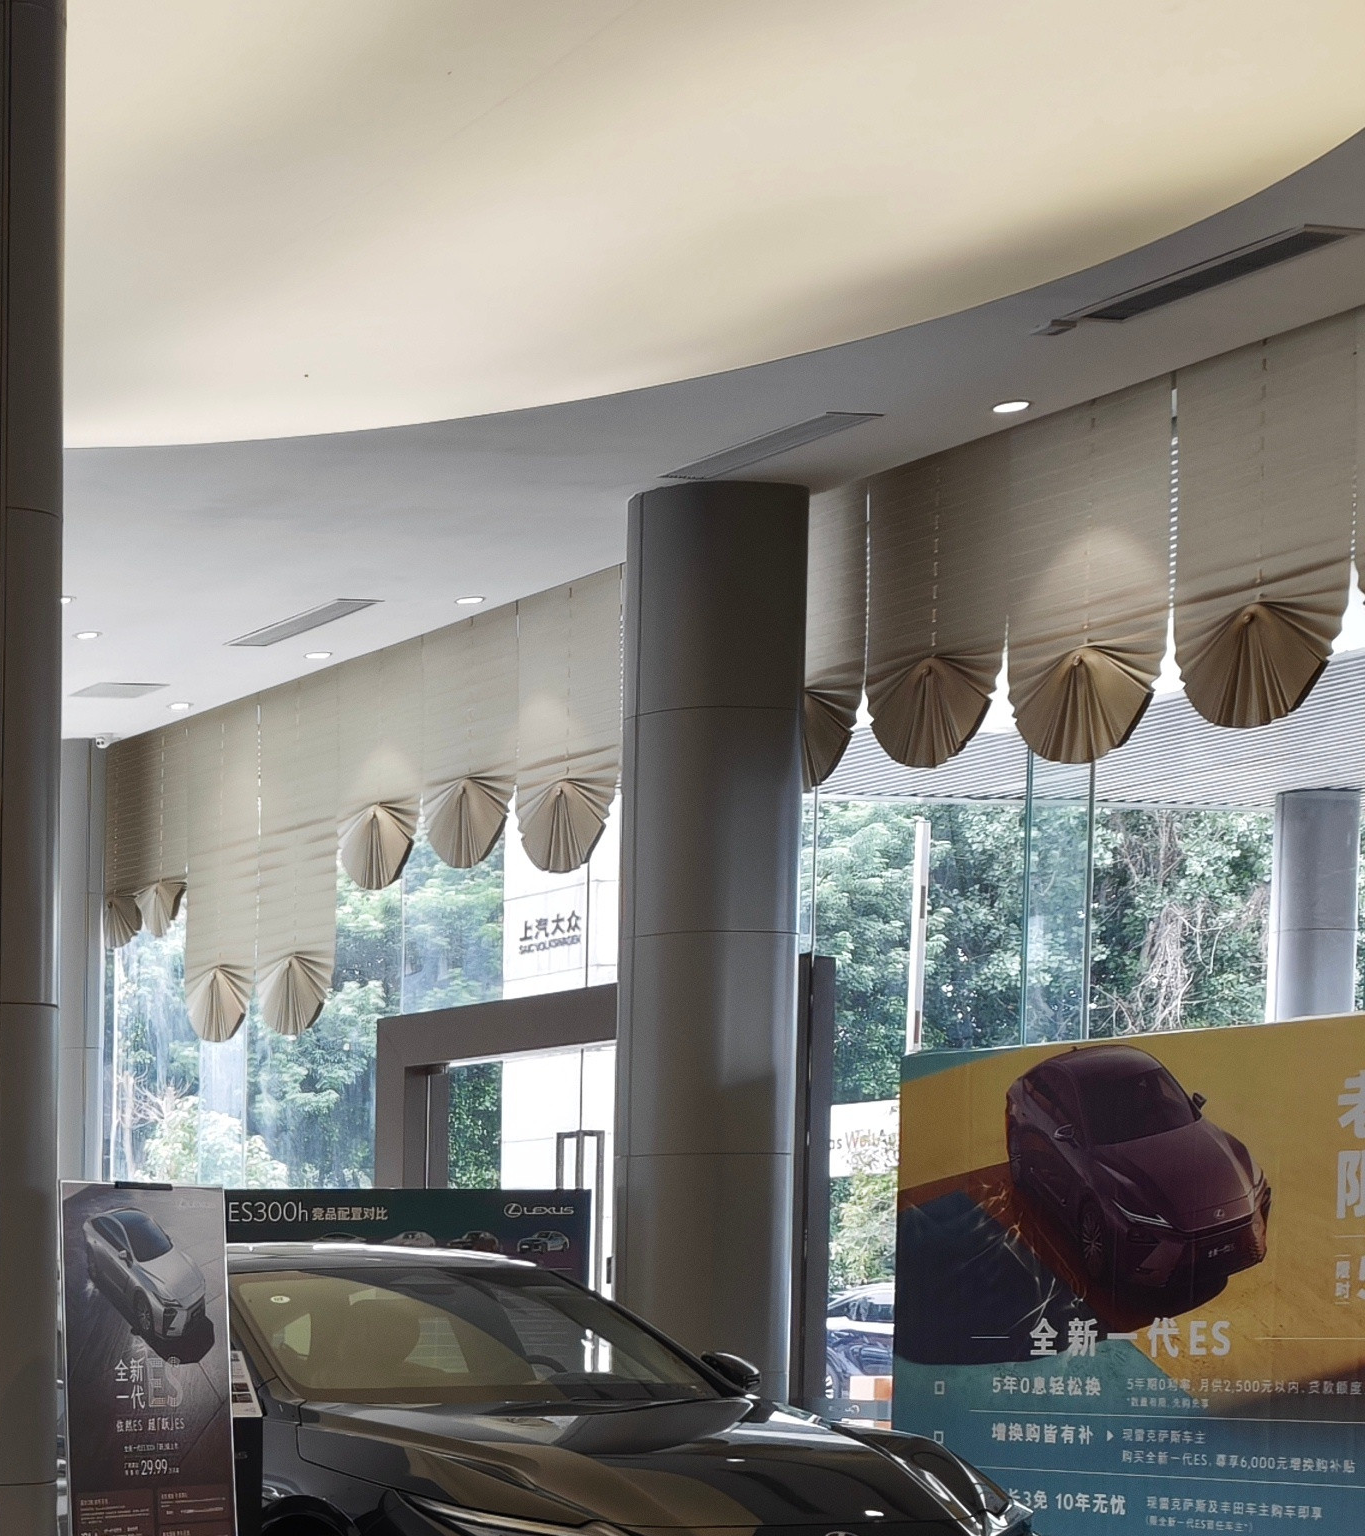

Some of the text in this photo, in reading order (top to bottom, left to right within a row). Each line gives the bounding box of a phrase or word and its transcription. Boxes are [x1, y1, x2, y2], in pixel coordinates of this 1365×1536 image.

[519, 910, 581, 942] 上汽大众
[228, 1201, 309, 1223] ES300h
[312, 1206, 389, 1222] 竞品配置对比
[524, 1205, 575, 1216] LEXUS
[1029, 1317, 1232, 1359] 全新一代ES
[114, 1357, 145, 1383] 全新
[115, 1386, 146, 1410] 一代
[992, 1375, 1102, 1397] 5年0息轻松换
[991, 1421, 1095, 1445] 增换购皆有补
[140, 1458, 169, 1476] 29.99
[1055, 1492, 1127, 1516] 10年无忧
